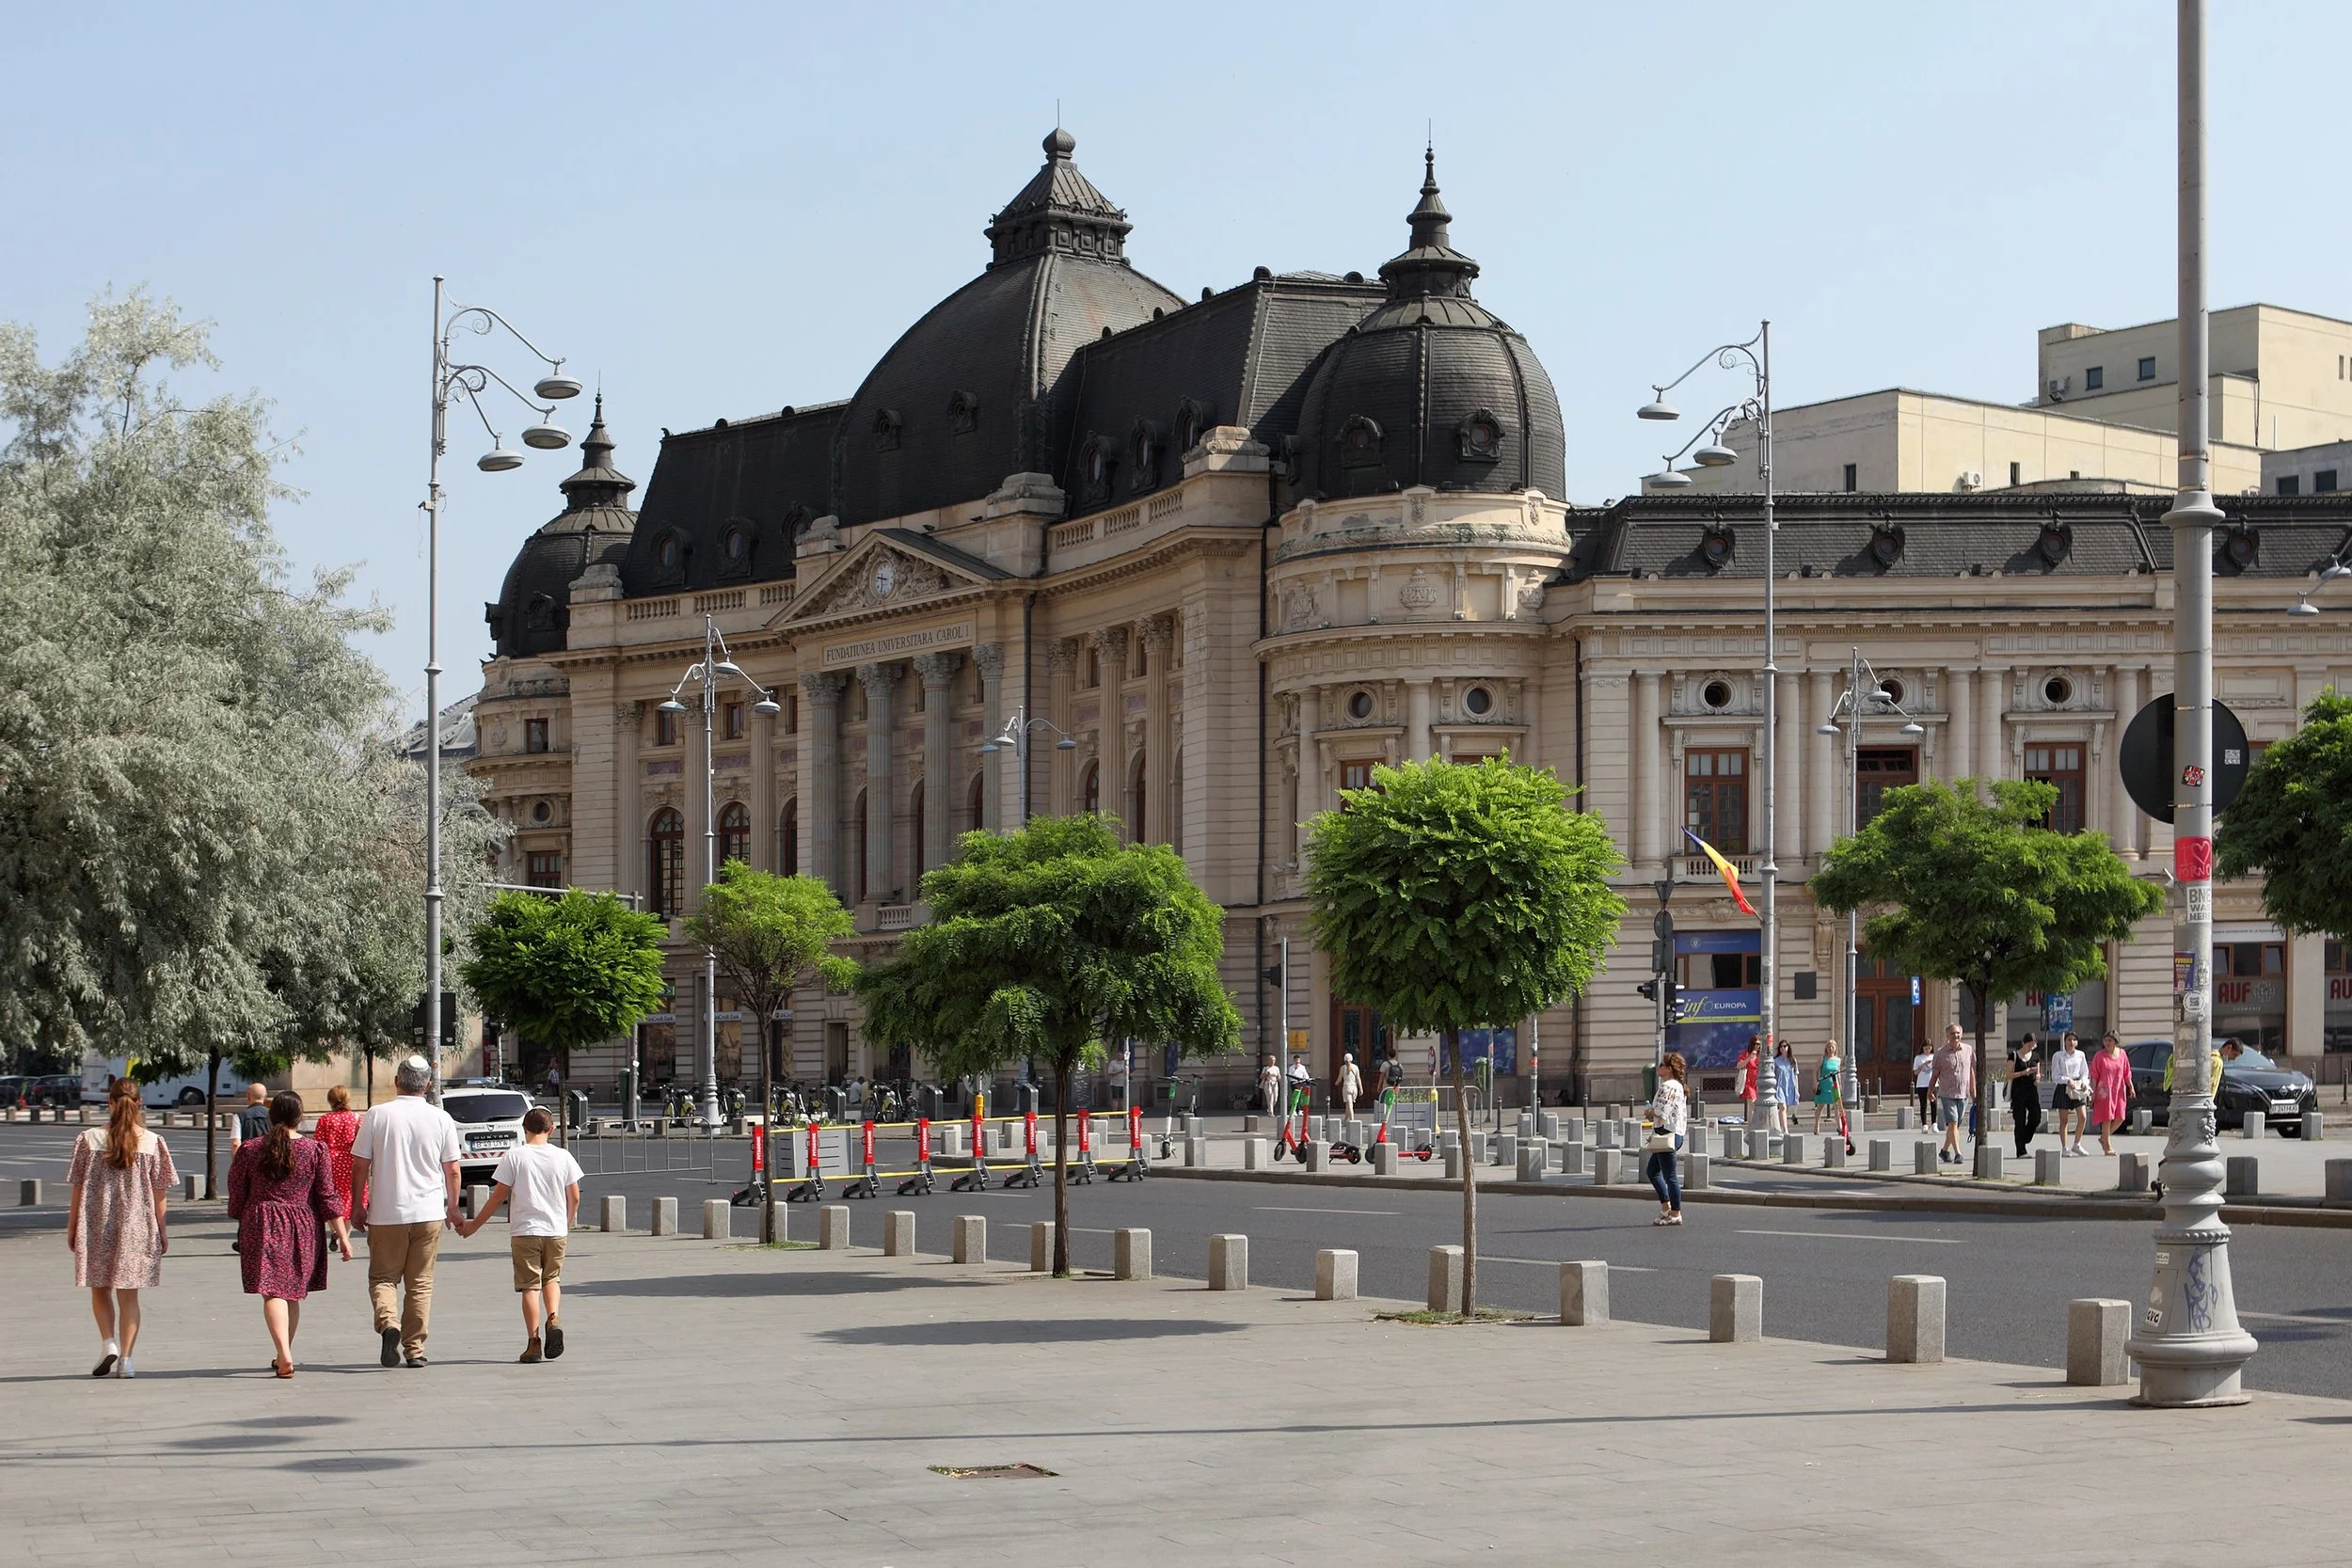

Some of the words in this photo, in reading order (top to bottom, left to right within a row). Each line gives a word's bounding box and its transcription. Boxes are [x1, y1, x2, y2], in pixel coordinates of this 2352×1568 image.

[936, 626, 963, 642] CAROL
[2189, 888, 2211, 904] BNE
[2189, 912, 2211, 922] HERE
[2218, 981, 2251, 1004] AUF
